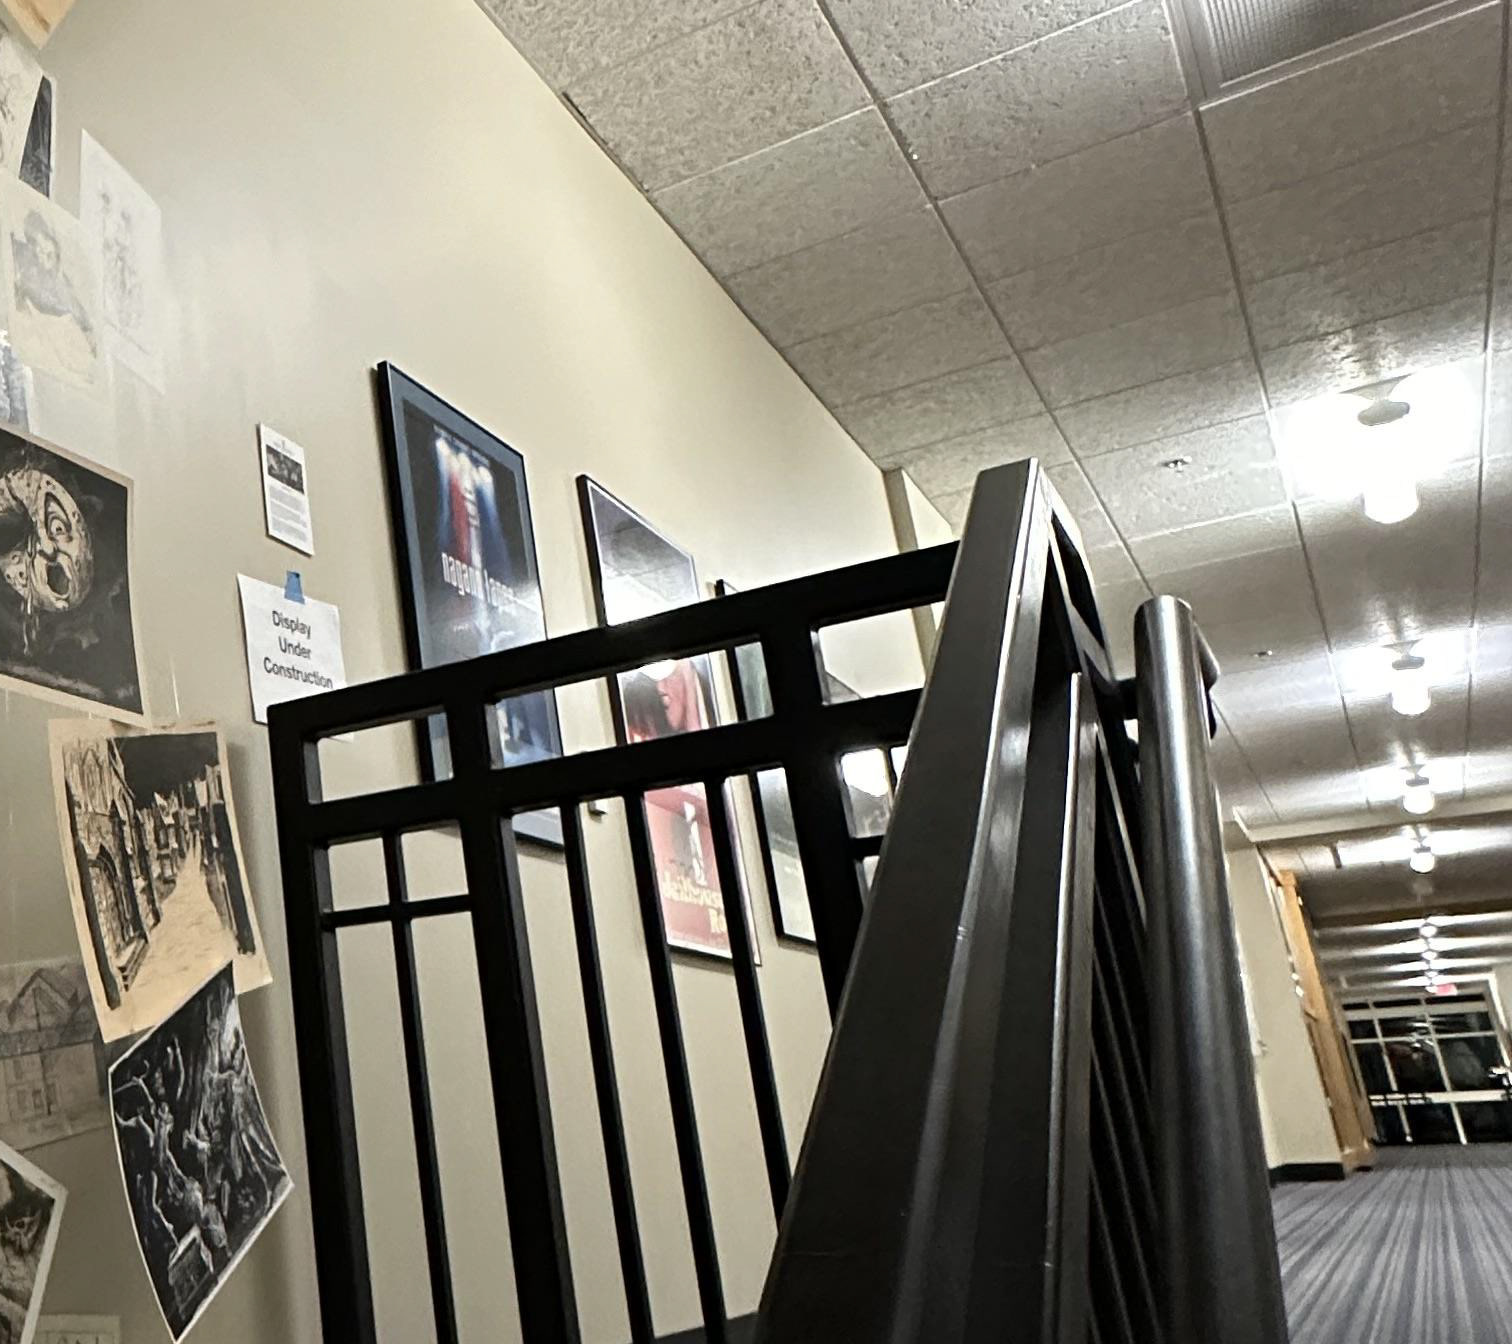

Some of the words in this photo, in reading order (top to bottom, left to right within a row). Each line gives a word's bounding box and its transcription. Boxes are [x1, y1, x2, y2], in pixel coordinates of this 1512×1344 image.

[271, 610, 311, 639] Display
[278, 636, 312, 660] Under
[263, 656, 334, 690] Construction
